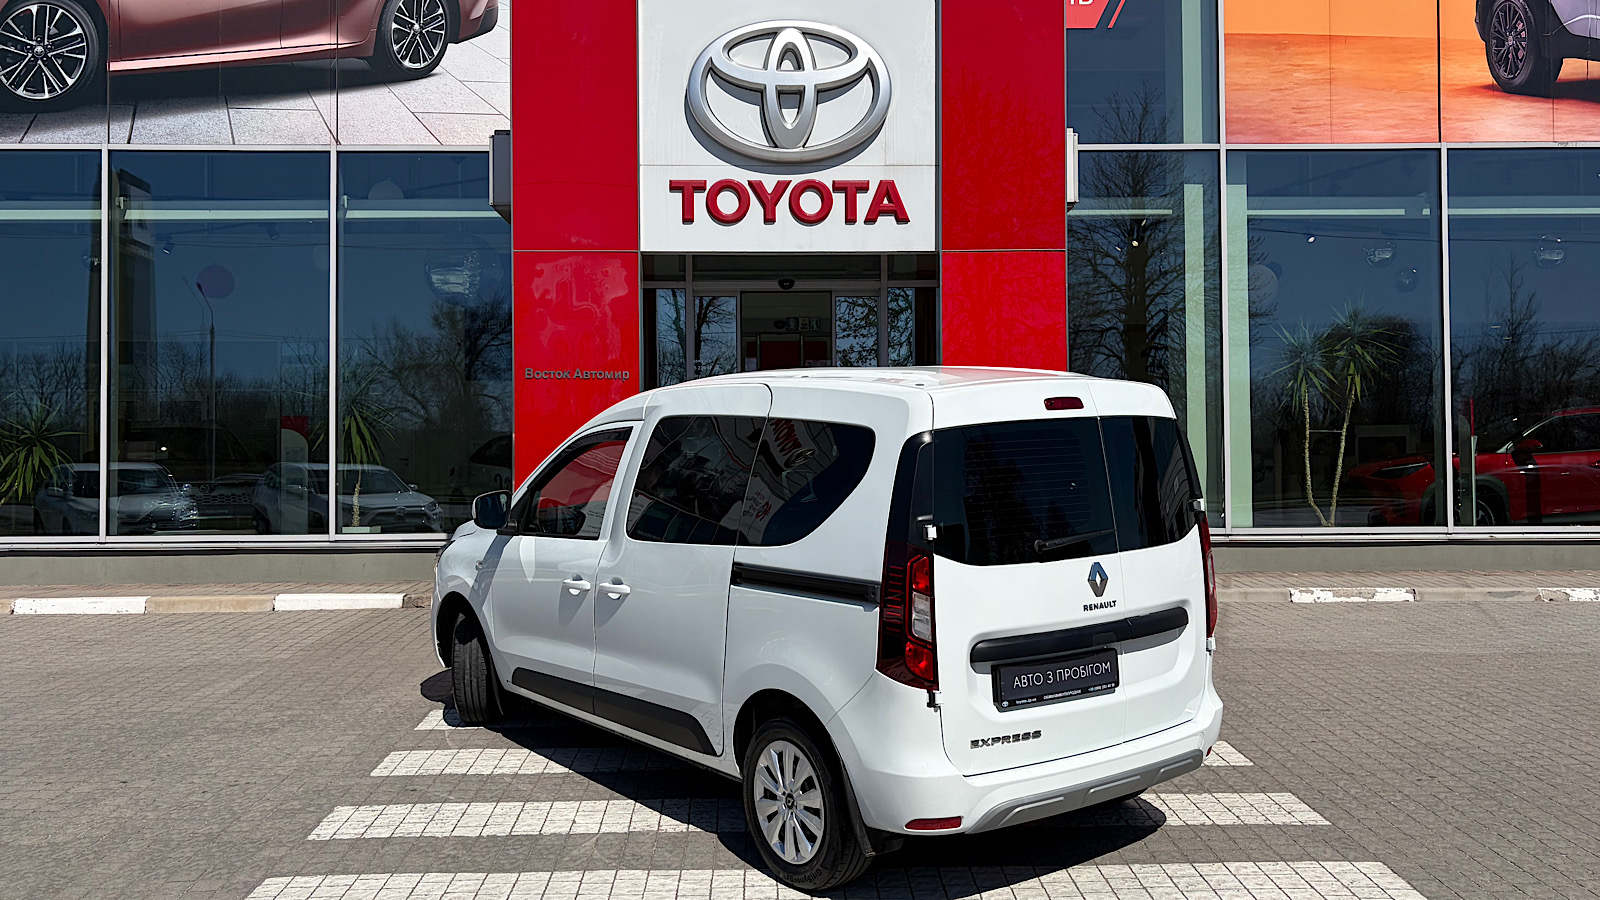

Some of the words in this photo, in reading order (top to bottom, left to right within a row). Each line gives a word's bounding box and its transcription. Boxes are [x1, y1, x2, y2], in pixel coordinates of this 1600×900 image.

[669, 178, 911, 226] TOYOTA
[525, 367, 571, 380] Восток
[573, 368, 630, 382] Автомир
[1083, 600, 1117, 612] RENAULT
[1013, 672, 1043, 689] АВТО
[1056, 661, 1111, 682] ПРОБІГОМ
[970, 730, 1042, 749] EXPRESS
